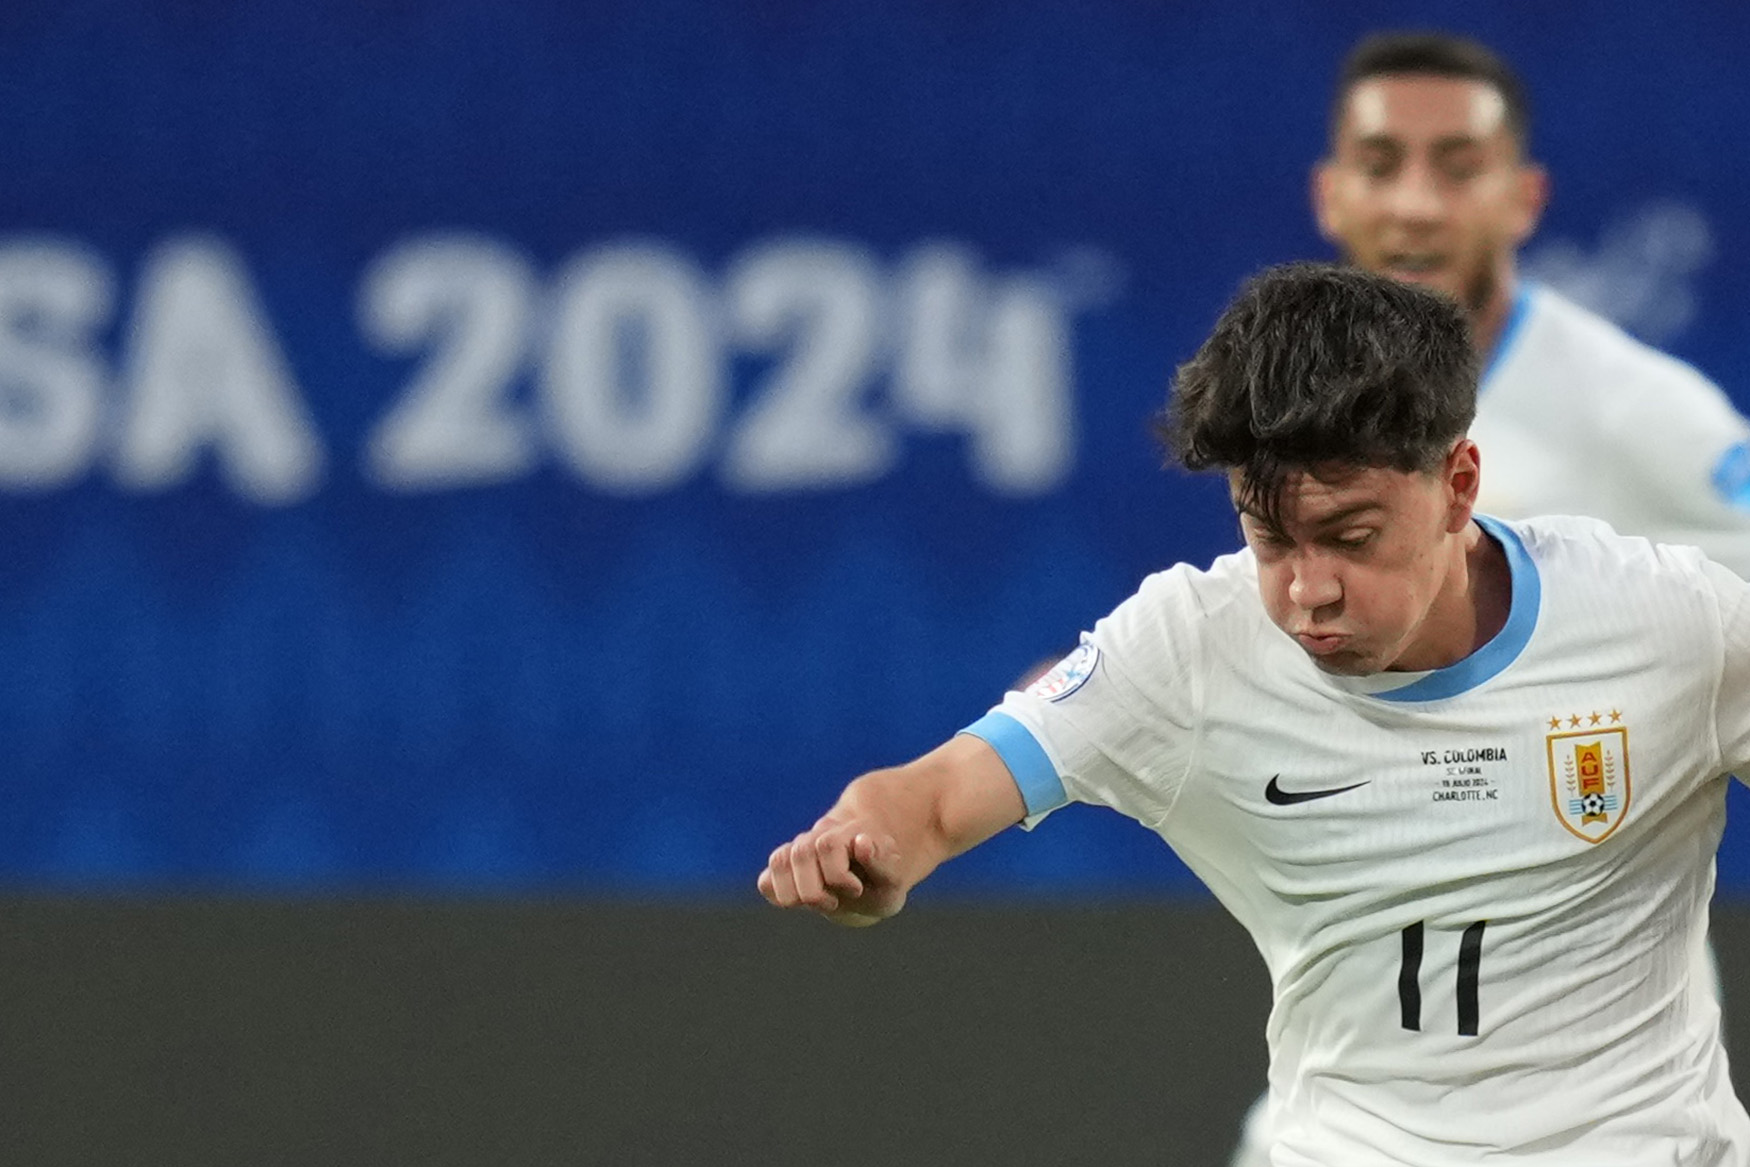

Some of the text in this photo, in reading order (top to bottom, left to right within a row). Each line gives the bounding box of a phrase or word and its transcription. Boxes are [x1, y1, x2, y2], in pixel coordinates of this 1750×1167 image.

[357, 236, 1073, 496] 2024
[1421, 747, 1507, 765] VS. COLOMBIA
[1581, 751, 1600, 790] AUF
[1486, 788, 1498, 800] NC
[1398, 919, 1487, 1037] 11
